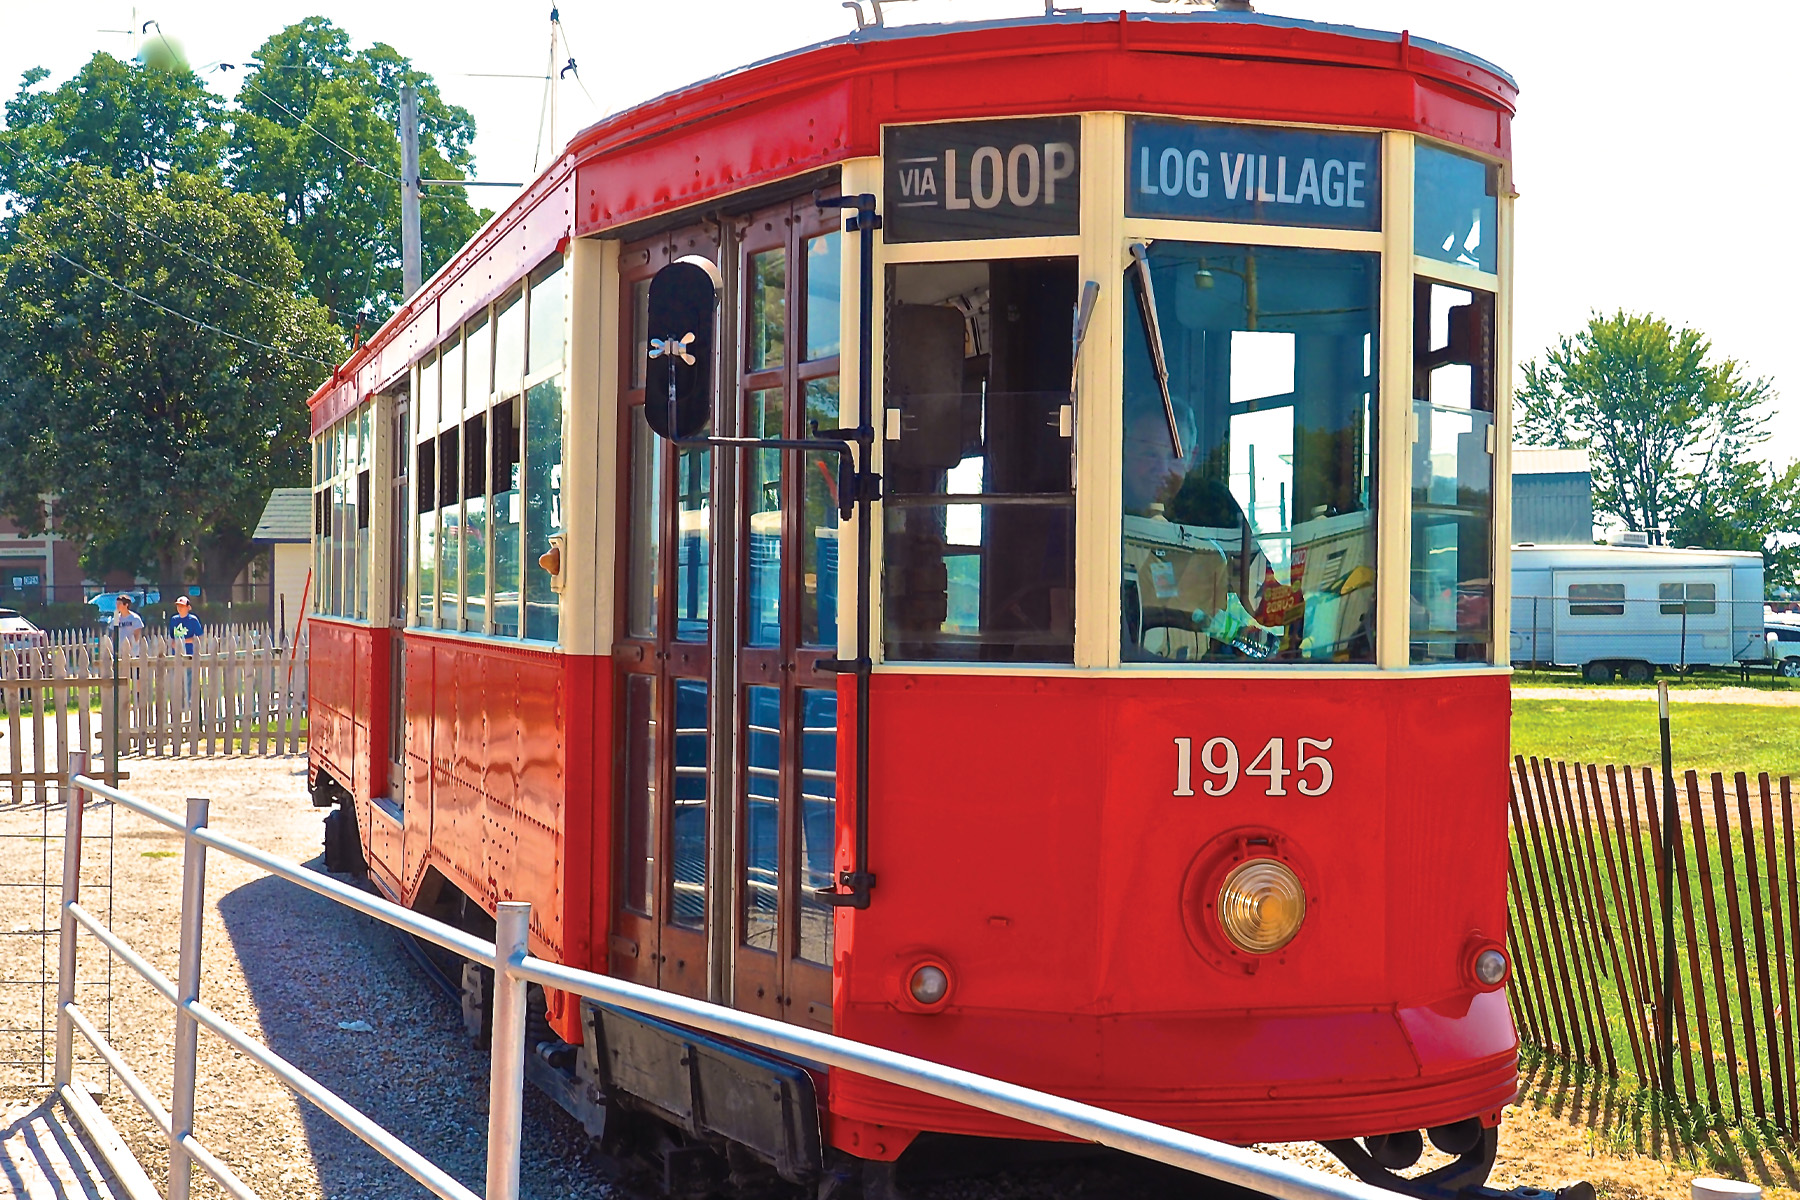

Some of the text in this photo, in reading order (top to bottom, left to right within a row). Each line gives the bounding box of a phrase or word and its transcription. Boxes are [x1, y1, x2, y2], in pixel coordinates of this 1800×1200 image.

[900, 143, 1076, 211] VIA LOOP
[1140, 146, 1366, 208] LOG VILLAGE
[1172, 736, 1334, 797] 1945
